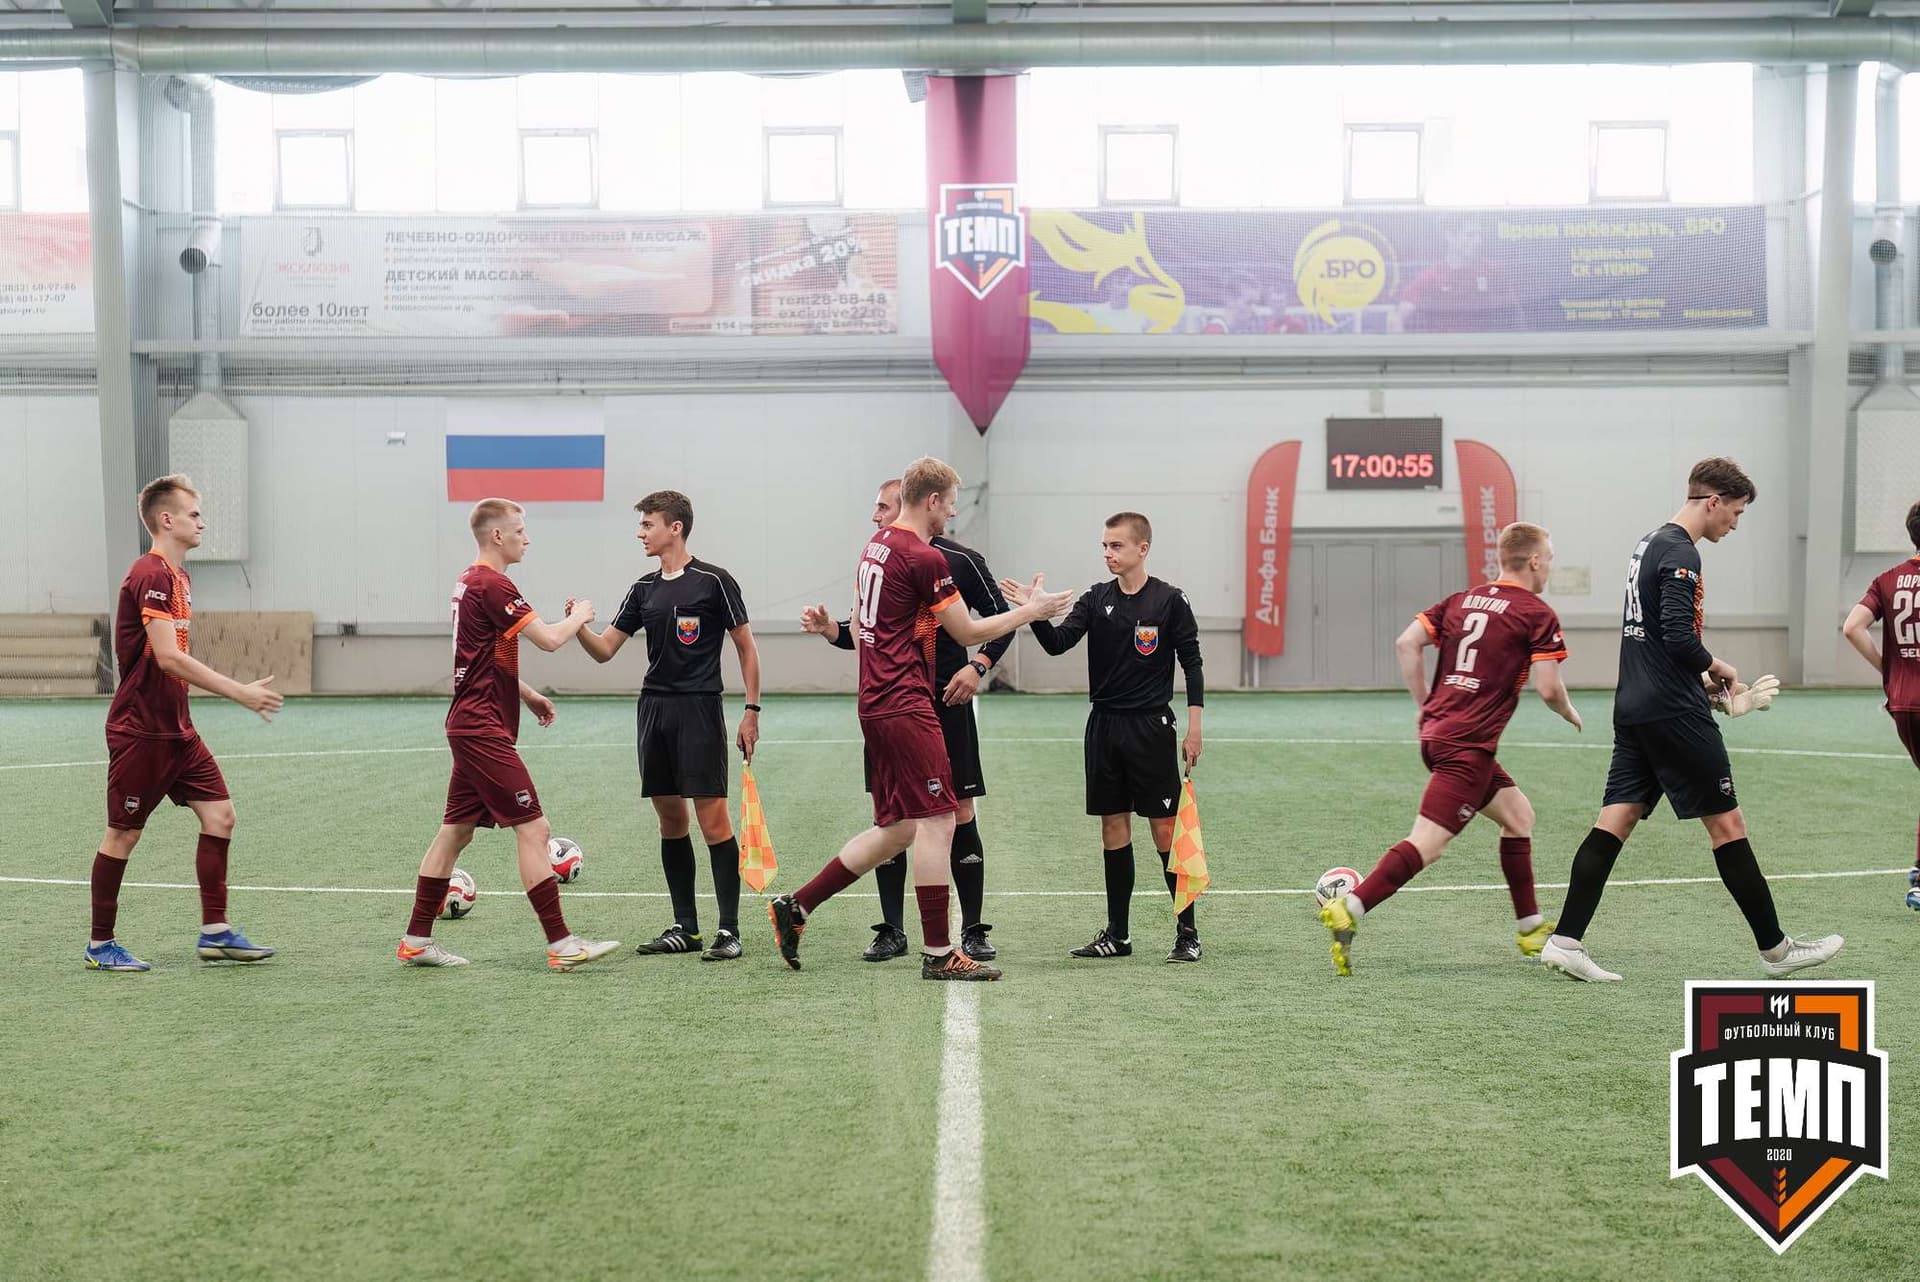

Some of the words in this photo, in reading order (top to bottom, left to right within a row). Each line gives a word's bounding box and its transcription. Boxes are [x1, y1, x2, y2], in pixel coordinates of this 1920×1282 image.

[944, 216, 1016, 255] ТЕМП
[385, 267, 459, 283] ДЕТСКИЙ
[1320, 259, 1376, 278] .БРО
[252, 302, 309, 317] более
[316, 302, 369, 317] 10лет
[1331, 454, 1434, 478] 17:00:55
[1260, 486, 1279, 544] Банк
[1255, 549, 1279, 625] Альфа
[1455, 612, 1489, 673] 2
